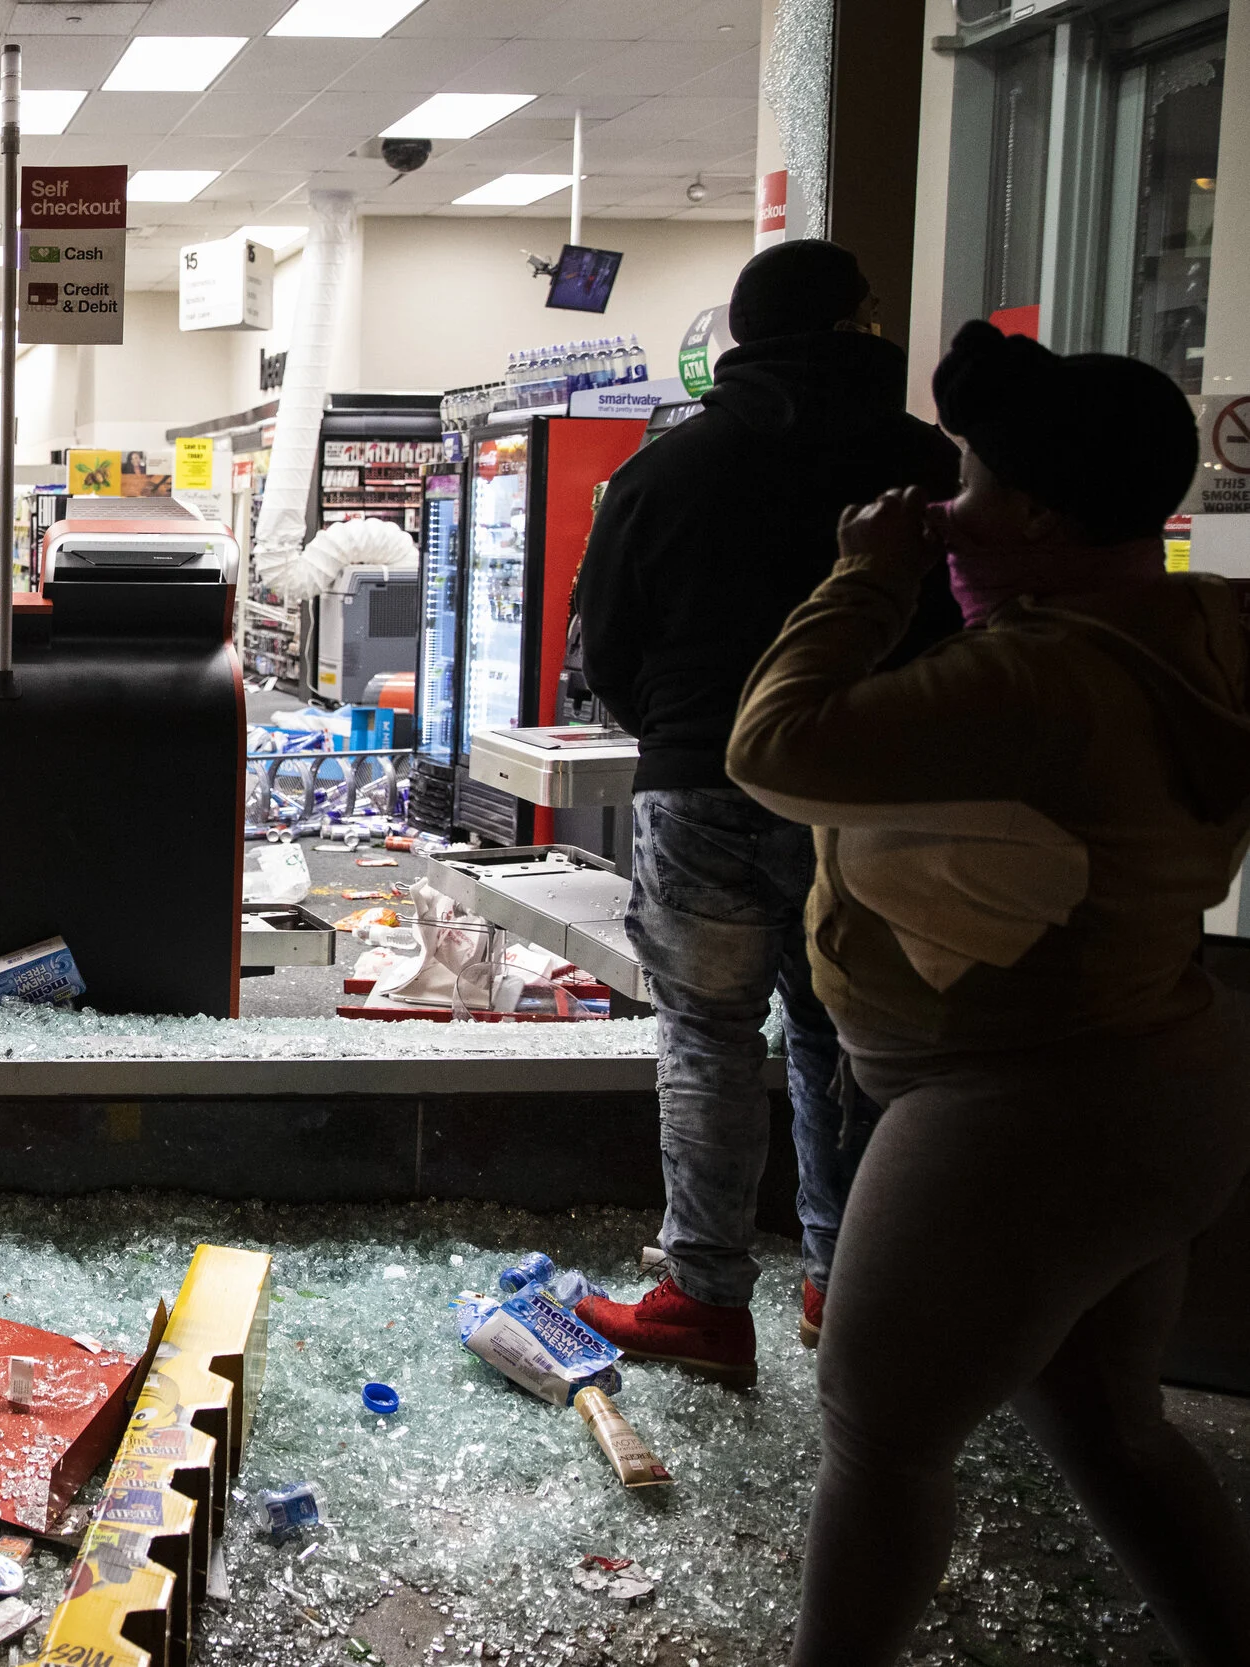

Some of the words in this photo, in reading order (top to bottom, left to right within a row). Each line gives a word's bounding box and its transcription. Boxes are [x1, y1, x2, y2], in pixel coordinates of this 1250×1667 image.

[31, 179, 69, 198] Self
[31, 198, 121, 216] checkout
[64, 246, 103, 260] Cash
[184, 251, 198, 270] 15
[63, 283, 110, 296] Credit
[63, 300, 74, 313] &
[78, 300, 118, 313] Debit
[683, 360, 707, 380] ATM
[598, 393, 662, 406] smartwater
[1214, 478, 1246, 490] THIS
[14, 963, 47, 985] FRESH
[17, 973, 53, 995] CHEWY
[530, 1294, 607, 1355] mentos
[537, 1317, 583, 1351] CHEWY
[535, 1324, 575, 1358] FRESH
